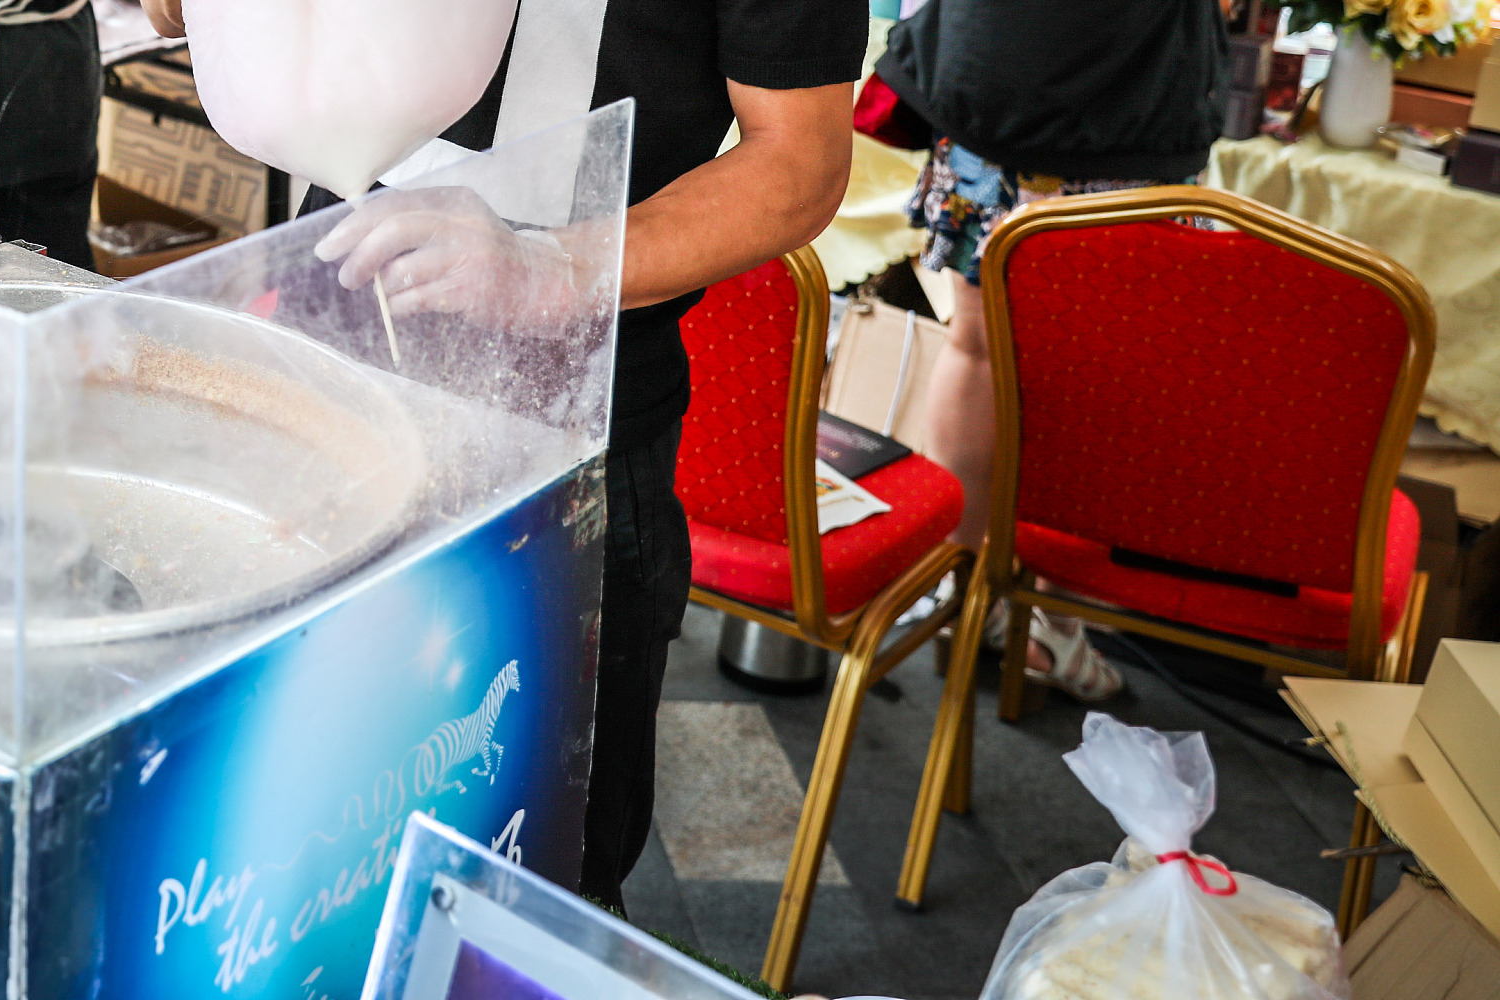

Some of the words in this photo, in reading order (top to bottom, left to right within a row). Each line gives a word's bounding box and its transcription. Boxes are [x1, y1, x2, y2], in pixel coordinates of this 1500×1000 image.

[155, 857, 254, 955] Play
[214, 898, 278, 992] the
[290, 820, 404, 942] creati
